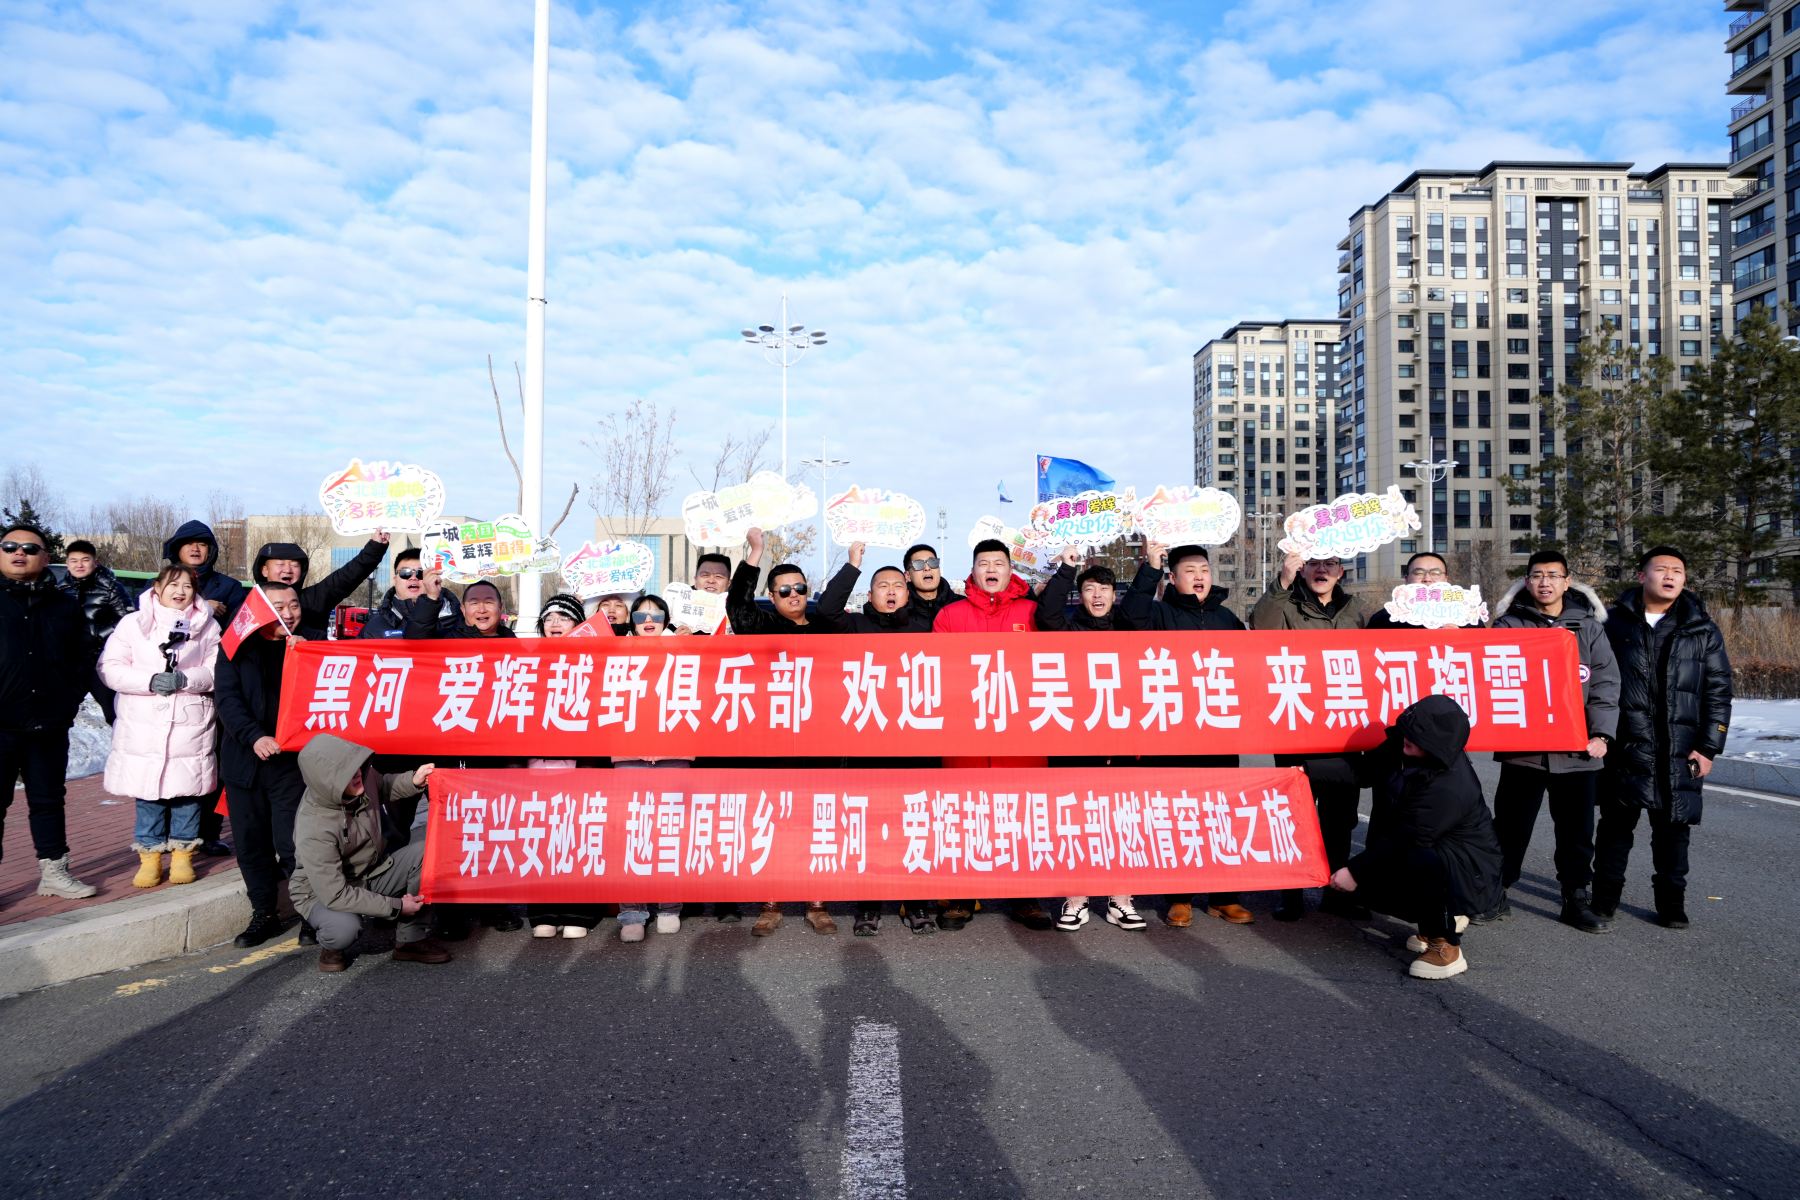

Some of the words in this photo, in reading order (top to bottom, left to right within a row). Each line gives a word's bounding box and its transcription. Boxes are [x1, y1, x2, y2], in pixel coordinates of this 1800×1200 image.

[348, 500, 418, 519] 多彩爱辉
[1057, 496, 1116, 520] 黑河爱辉
[1314, 498, 1382, 529] 黑河爱辉
[425, 522, 496, 542] 一城两国
[1055, 513, 1115, 538] 欢迎你
[1316, 514, 1386, 548] 欢迎你
[462, 540, 524, 559] 爱辉值得
[583, 568, 635, 586] 多彩爱辉
[1416, 588, 1464, 602] 黑河爱辉
[304, 654, 413, 732] 黑河
[432, 652, 813, 733] 爱辉越野俱乐部
[841, 651, 944, 732] 欢迎
[971, 647, 1241, 732] 孙吴兄弟连
